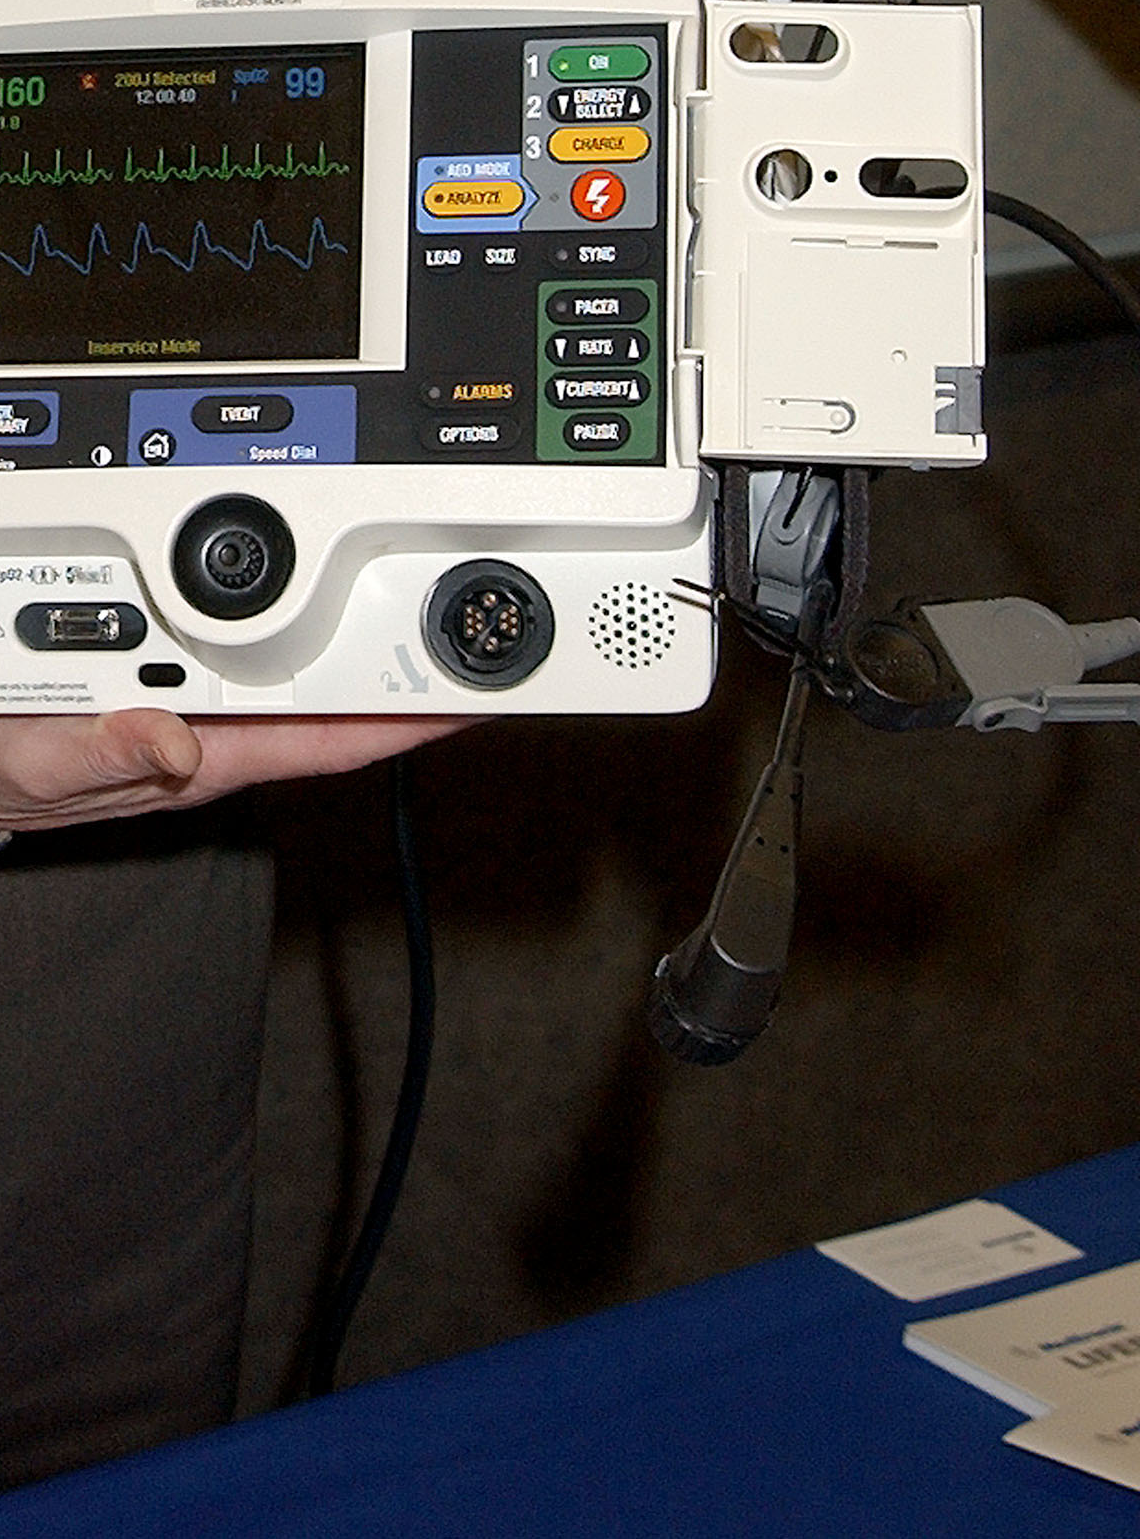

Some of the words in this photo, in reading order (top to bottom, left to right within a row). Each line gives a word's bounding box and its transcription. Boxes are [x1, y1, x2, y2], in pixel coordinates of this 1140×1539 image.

[526, 55, 539, 77] 1
[588, 55, 609, 70] ON
[152, 69, 217, 86] Selected
[285, 66, 325, 99] 99
[526, 95, 542, 119] 2
[574, 88, 627, 104] ENERGY
[575, 103, 624, 118] SELECT
[525, 136, 541, 159] 3
[572, 136, 625, 151] CHARGE
[447, 190, 501, 205] ANALYZE
[425, 249, 462, 265] LEAD
[485, 248, 516, 264] SIZE
[578, 246, 616, 263] SYNC
[574, 298, 620, 315] PACER
[87, 339, 158, 356] Inservice
[159, 339, 201, 354] Mode
[578, 339, 614, 355] RATE
[453, 383, 514, 400] ALARMS
[566, 380, 629, 397] CURRENT
[438, 425, 499, 443] OPTIONS
[573, 423, 620, 441] PAUSE
[248, 445, 288, 460] Speed
[291, 445, 317, 460] Dial
